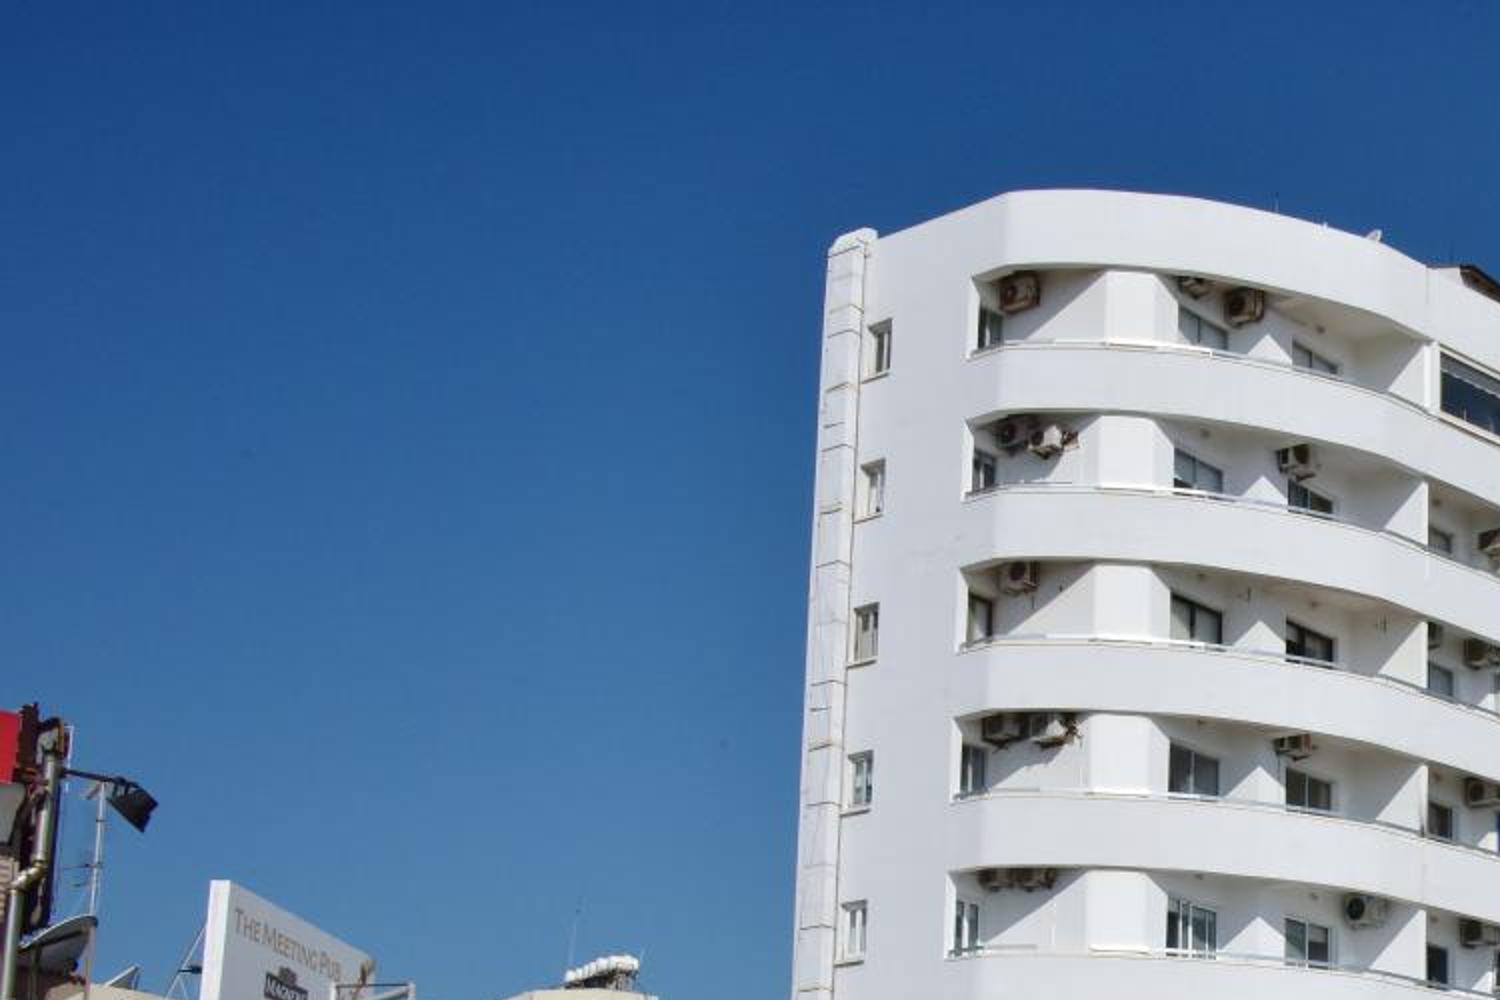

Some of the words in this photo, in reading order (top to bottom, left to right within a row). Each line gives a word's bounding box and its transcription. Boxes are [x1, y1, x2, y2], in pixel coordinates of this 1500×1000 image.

[234, 907, 262, 943] THE
[261, 920, 319, 972] MEETING
[319, 950, 342, 982] PUB
